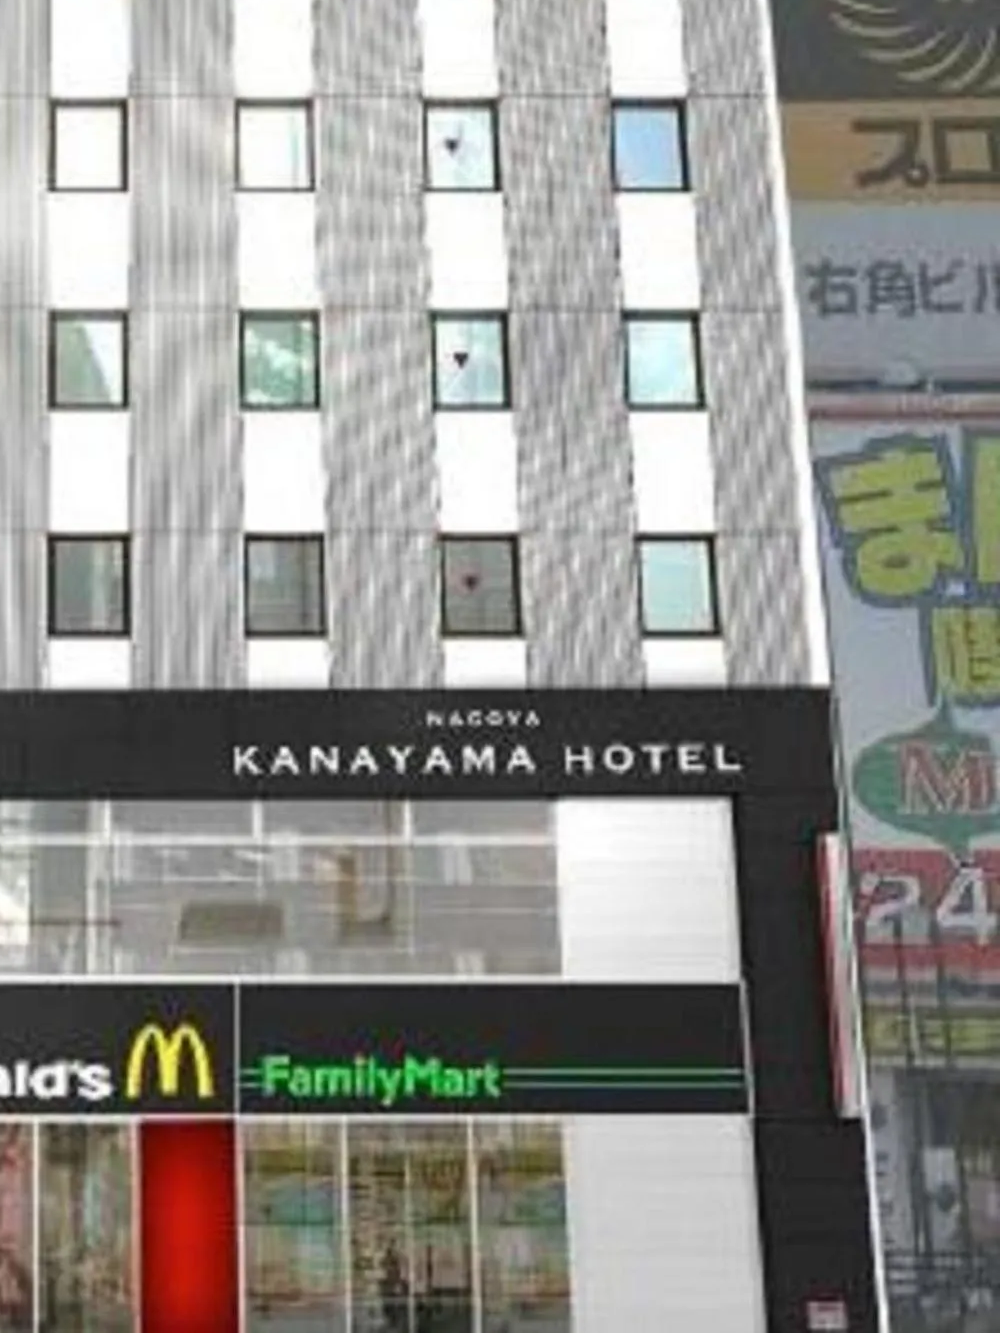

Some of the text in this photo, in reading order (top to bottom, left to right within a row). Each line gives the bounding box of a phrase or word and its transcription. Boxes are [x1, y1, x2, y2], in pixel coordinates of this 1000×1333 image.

[851, 117, 1000, 189] プロ
[427, 711, 539, 726] NAGOYA
[234, 744, 741, 774] KANAYAMA HOTEL
[258, 1053, 502, 1106] FamilyMart
